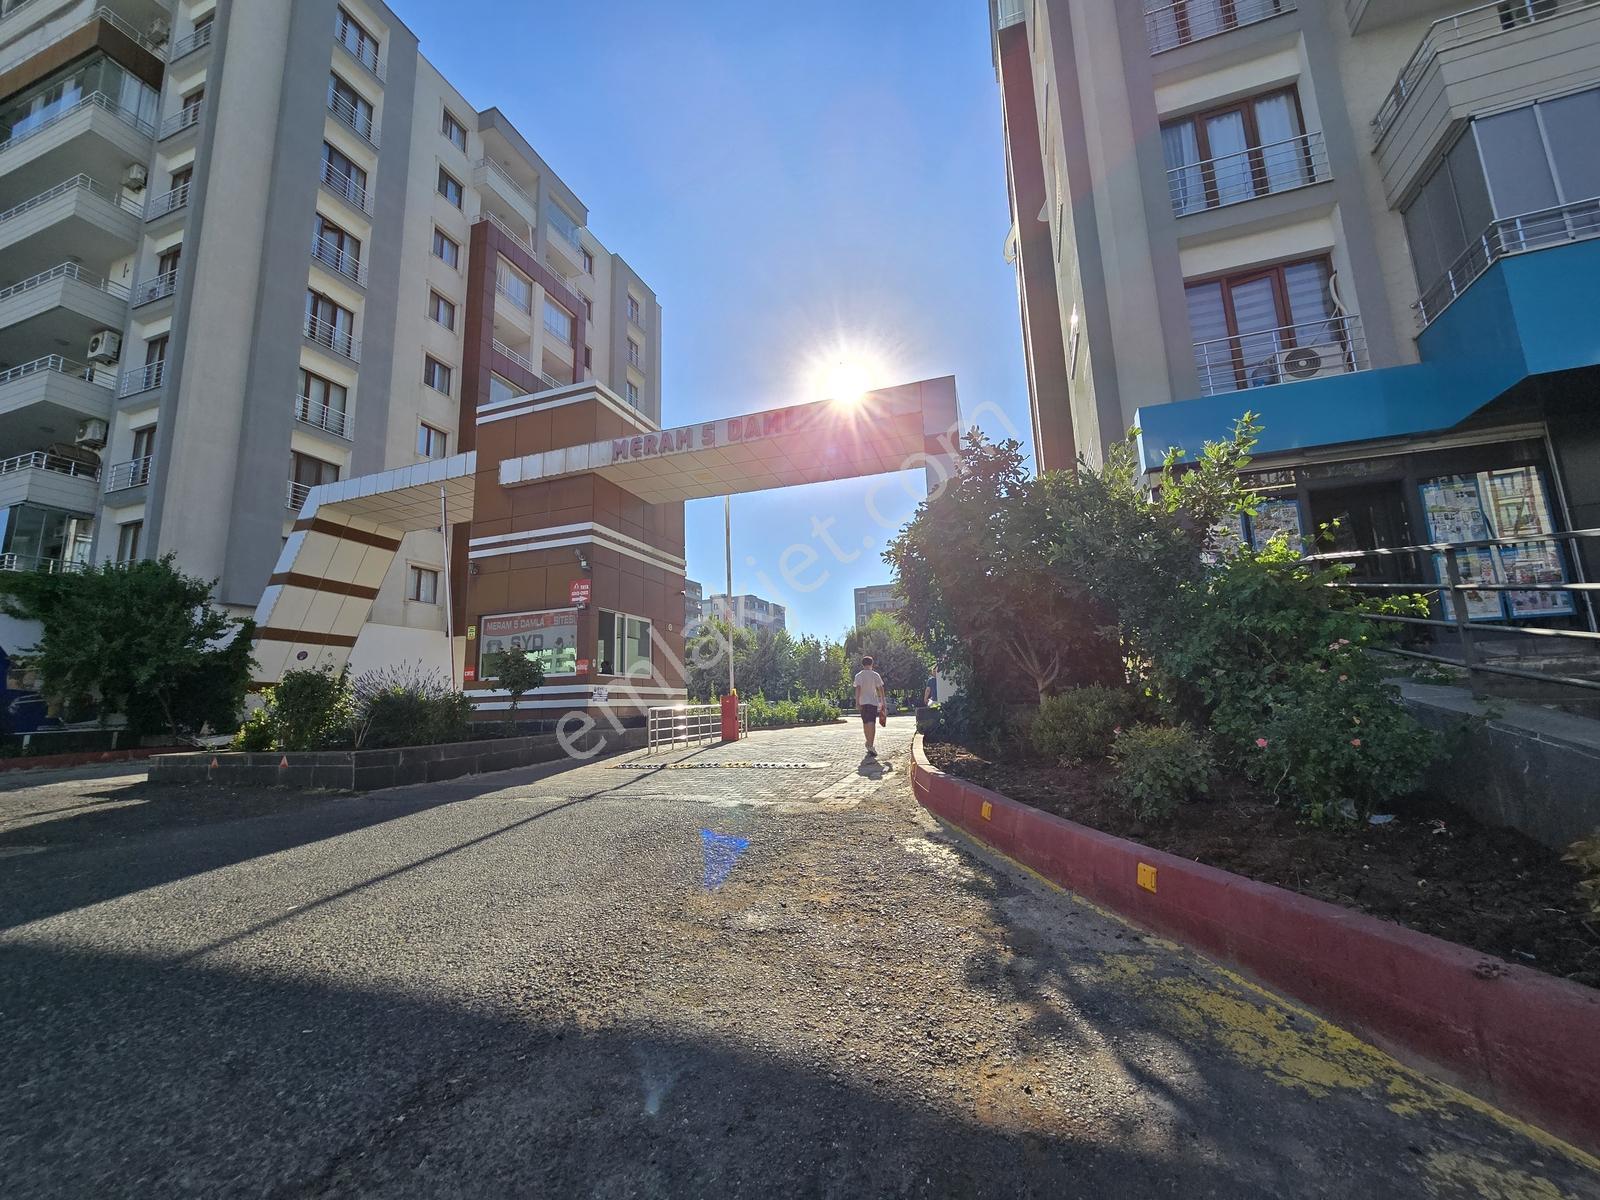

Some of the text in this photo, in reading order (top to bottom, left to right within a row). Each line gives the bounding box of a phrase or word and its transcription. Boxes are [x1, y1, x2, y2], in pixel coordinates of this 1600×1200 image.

[612, 406, 812, 462] MERAM 5 DAML
[487, 620, 512, 631] MERAM
[520, 616, 545, 628] DAMLA
